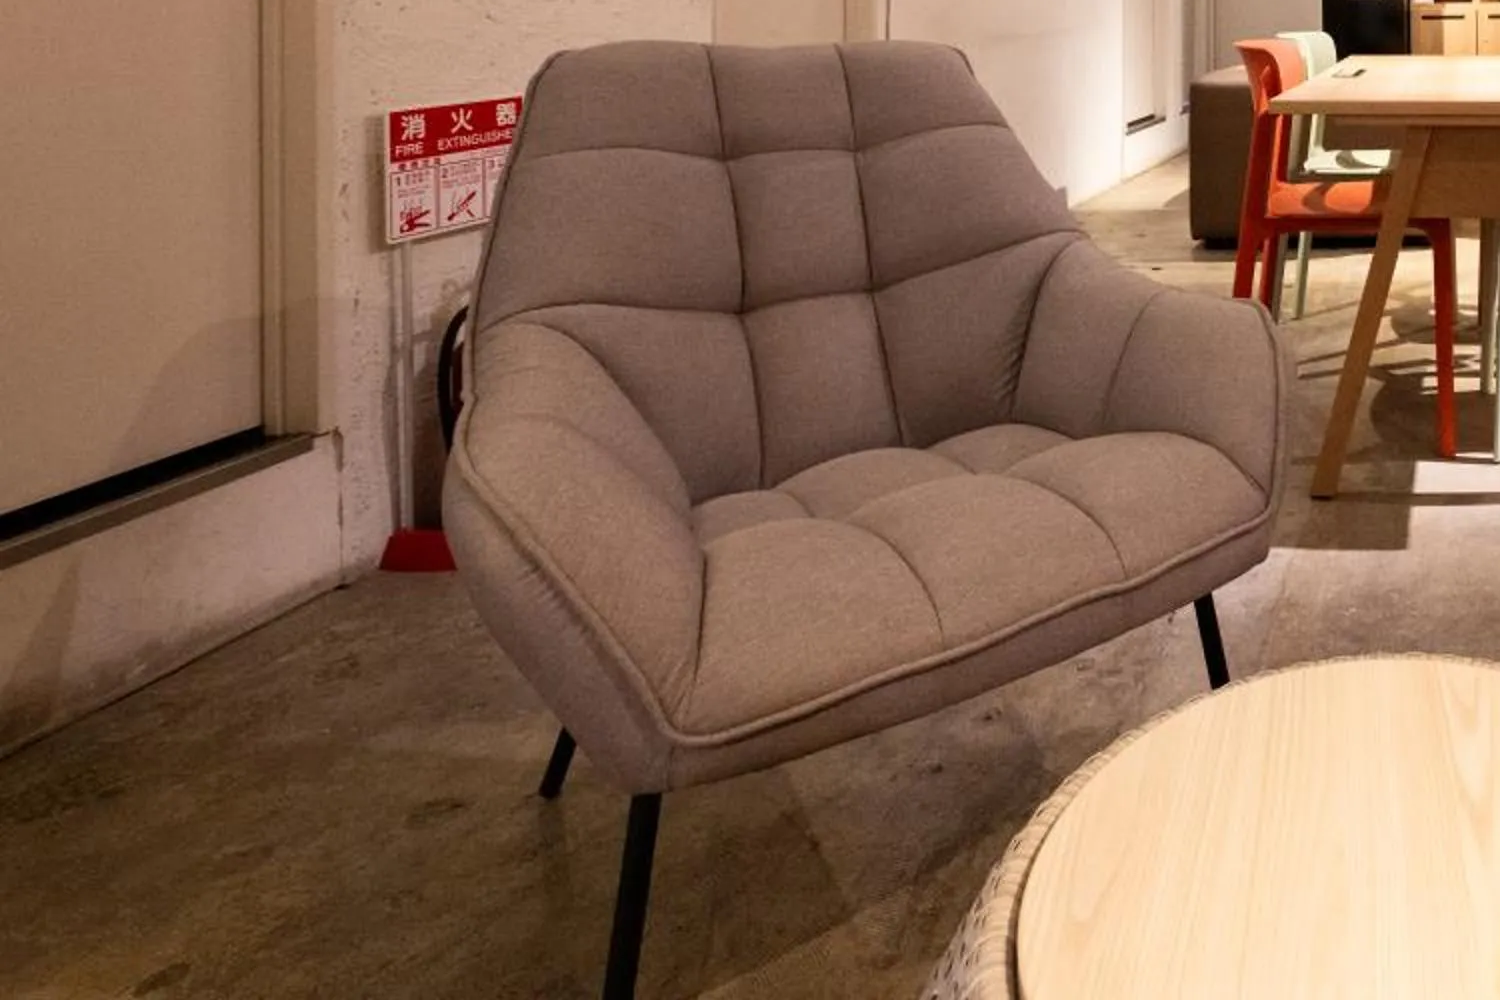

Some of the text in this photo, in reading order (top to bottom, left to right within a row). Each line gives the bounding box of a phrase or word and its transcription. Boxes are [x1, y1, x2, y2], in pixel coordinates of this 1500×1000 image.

[400, 102, 517, 140] 消火器
[395, 127, 513, 158] FIRE EXTINGUISHE
